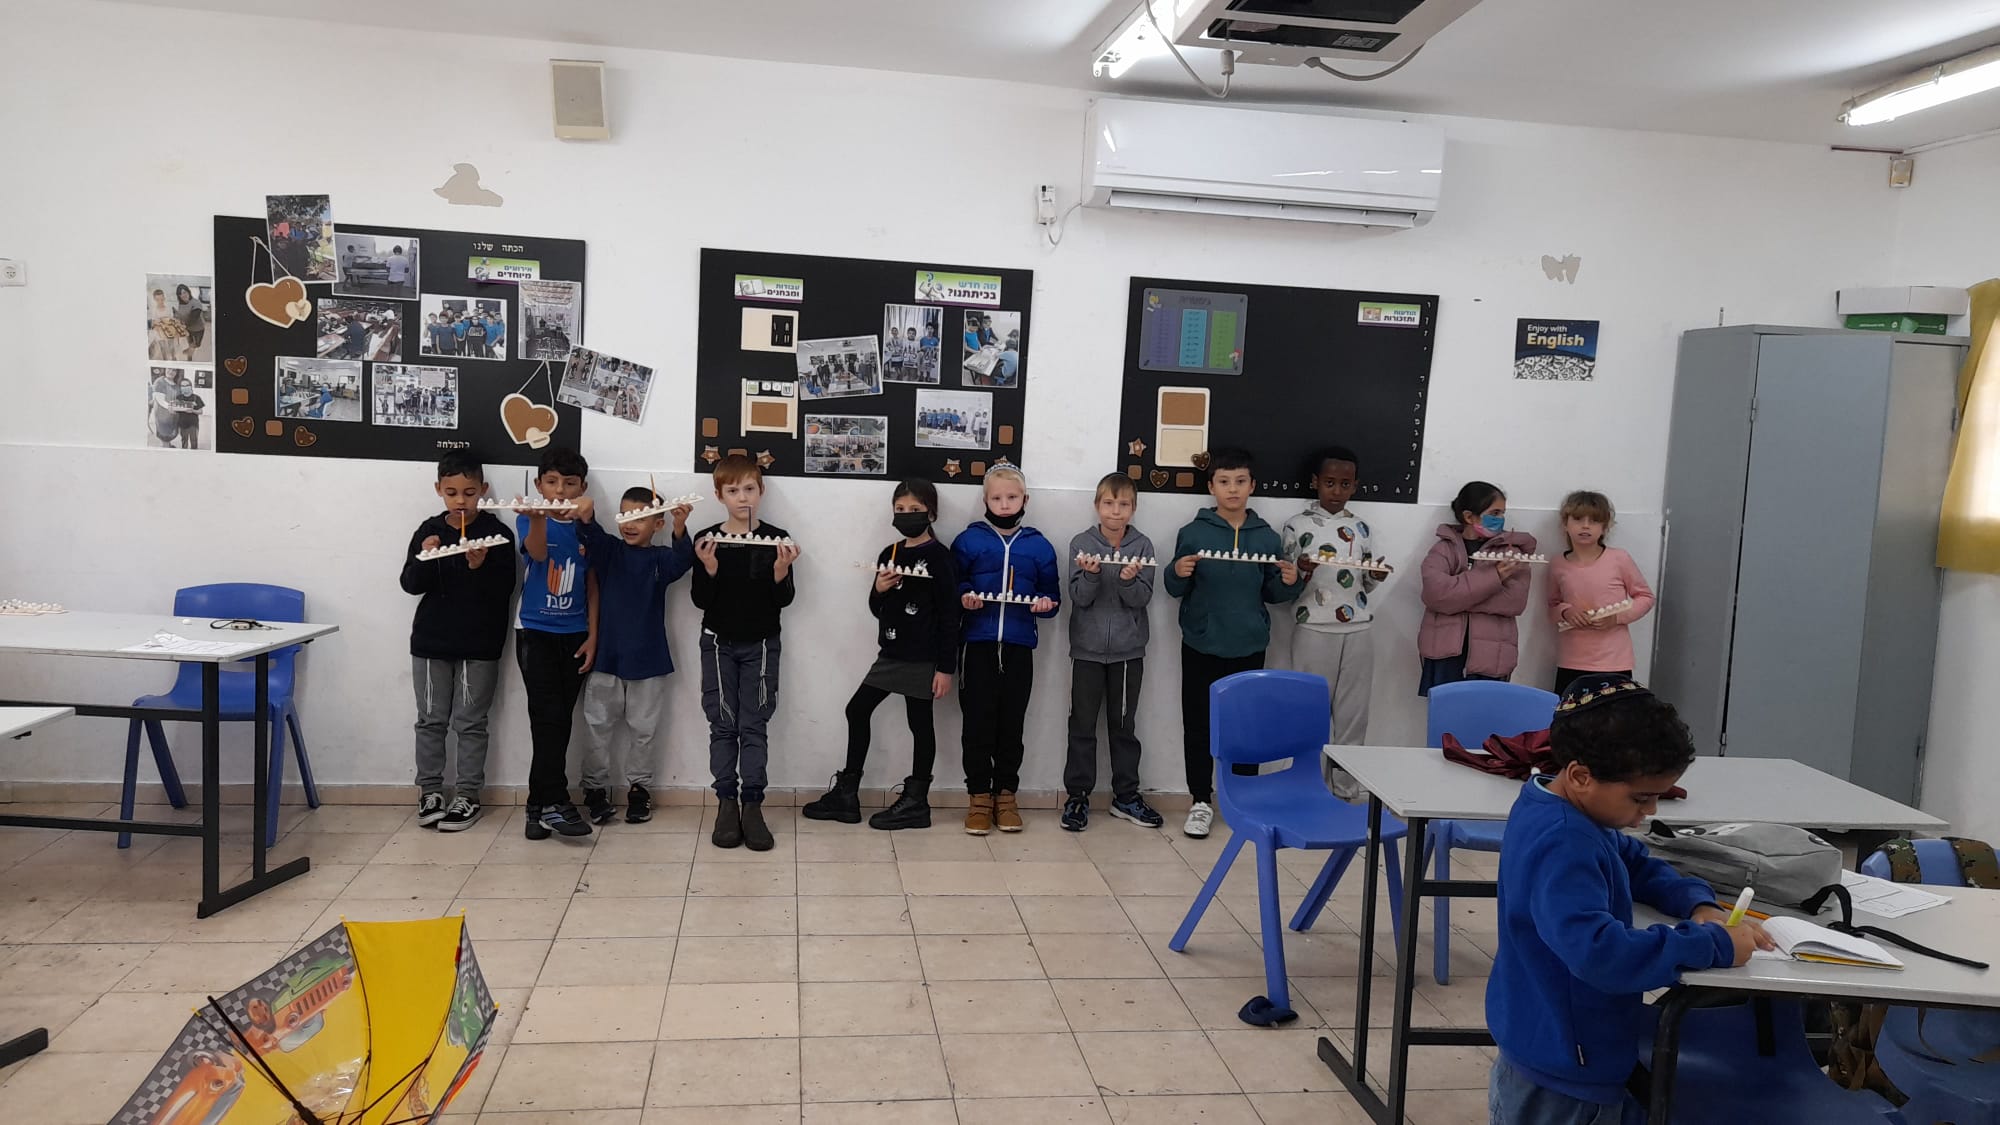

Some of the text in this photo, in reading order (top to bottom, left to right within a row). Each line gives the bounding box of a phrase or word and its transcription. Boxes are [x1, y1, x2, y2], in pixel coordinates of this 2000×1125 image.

[473, 241, 524, 253] הכתה שלנו
[497, 271, 532, 279] מיוחדים
[958, 280, 997, 290] מה חדש
[767, 289, 800, 297] ומבחנים
[947, 288, 997, 300] בכיתתנו?
[1383, 315, 1416, 323] ותזכורות
[1527, 324, 1549, 333] Enjoy
[1526, 332, 1585, 349] English
